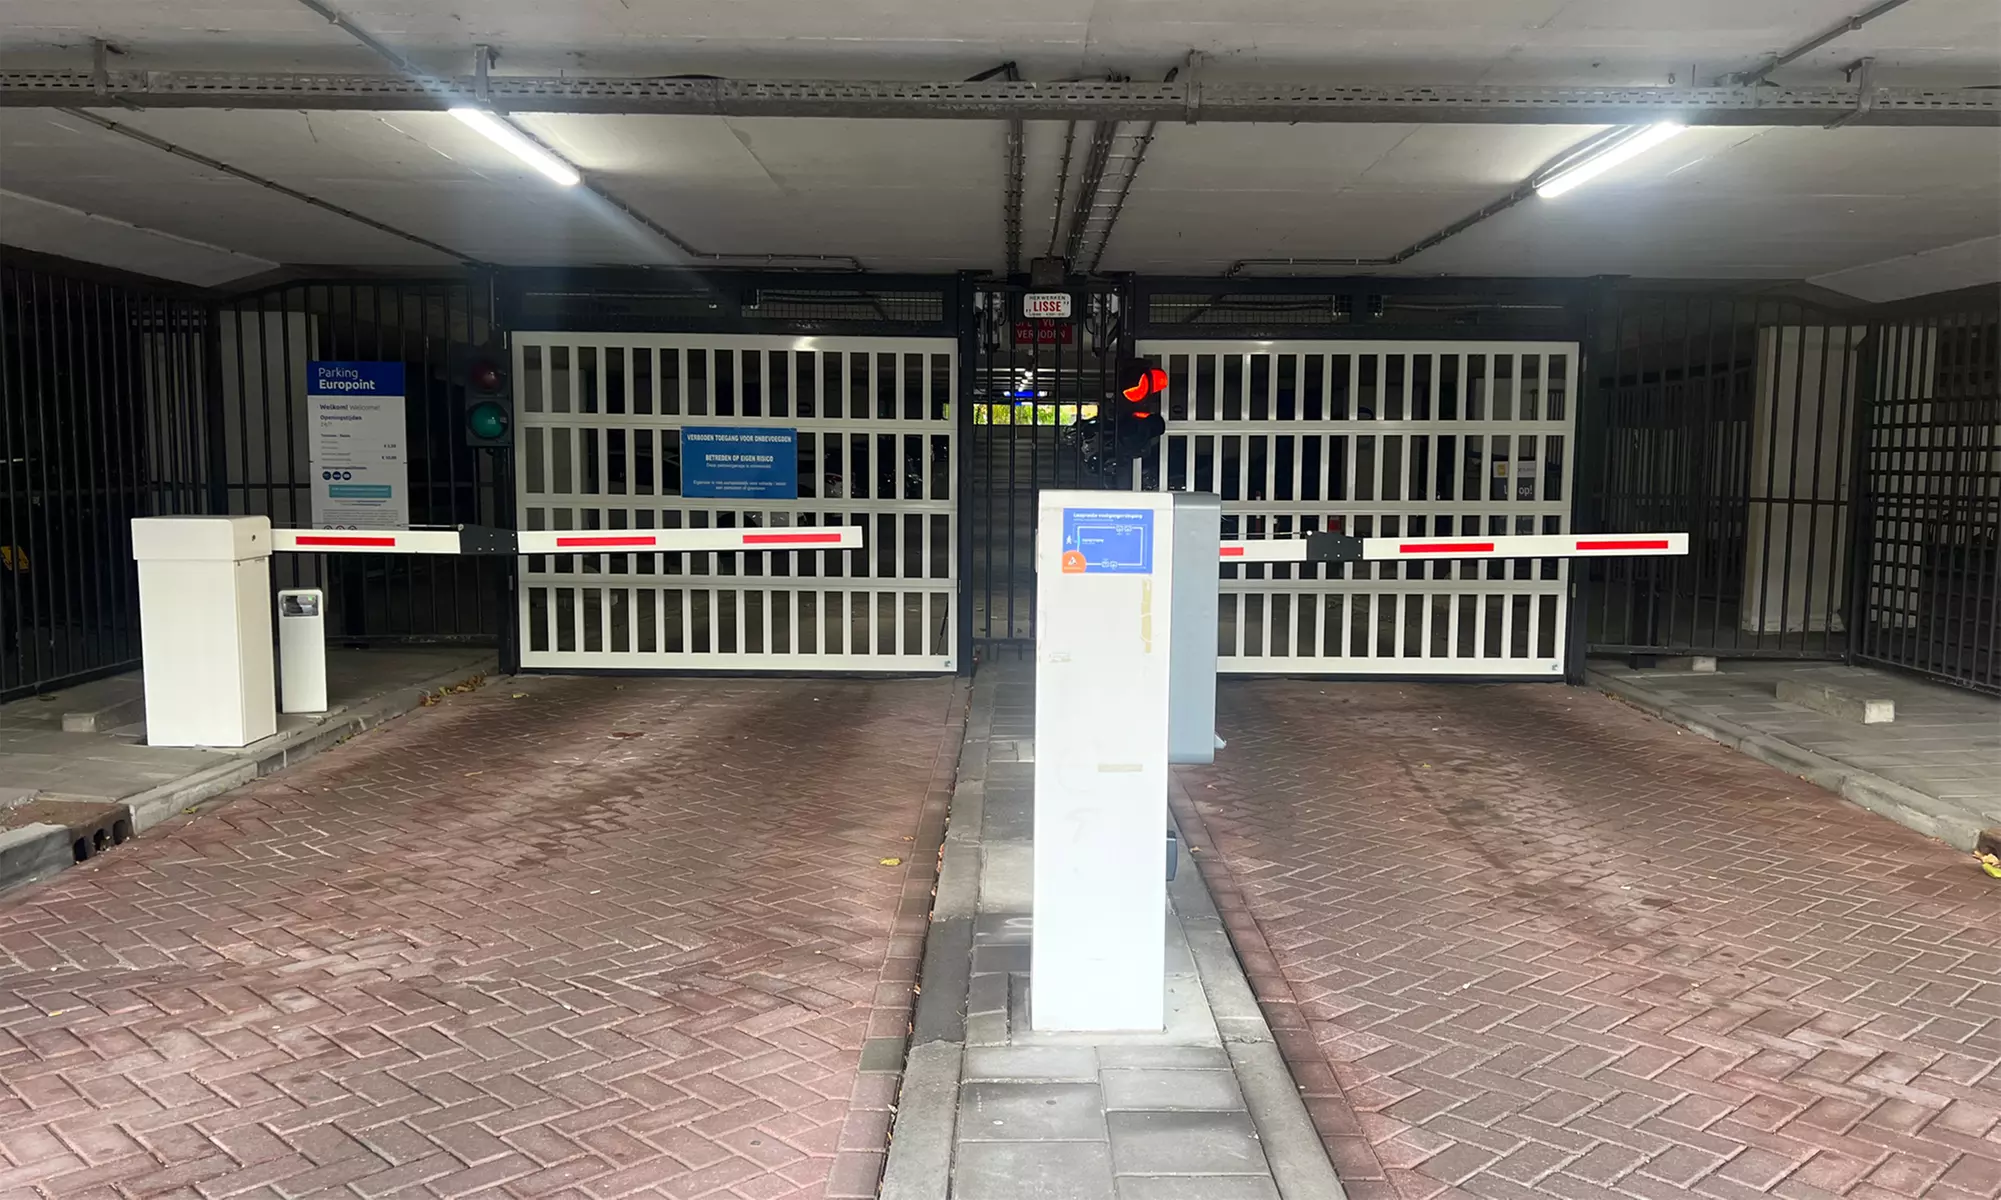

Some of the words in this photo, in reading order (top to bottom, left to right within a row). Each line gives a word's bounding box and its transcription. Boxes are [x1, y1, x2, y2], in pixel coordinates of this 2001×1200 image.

[1017, 329, 1066, 339] VERODEN
[318, 367, 359, 379] Parking
[319, 379, 376, 391] Europoint
[687, 434, 714, 442] VERBODEN
[715, 434, 739, 442] TOEGANG
[705, 454, 732, 462] BETREDEN
[1518, 485, 1533, 497] op!
